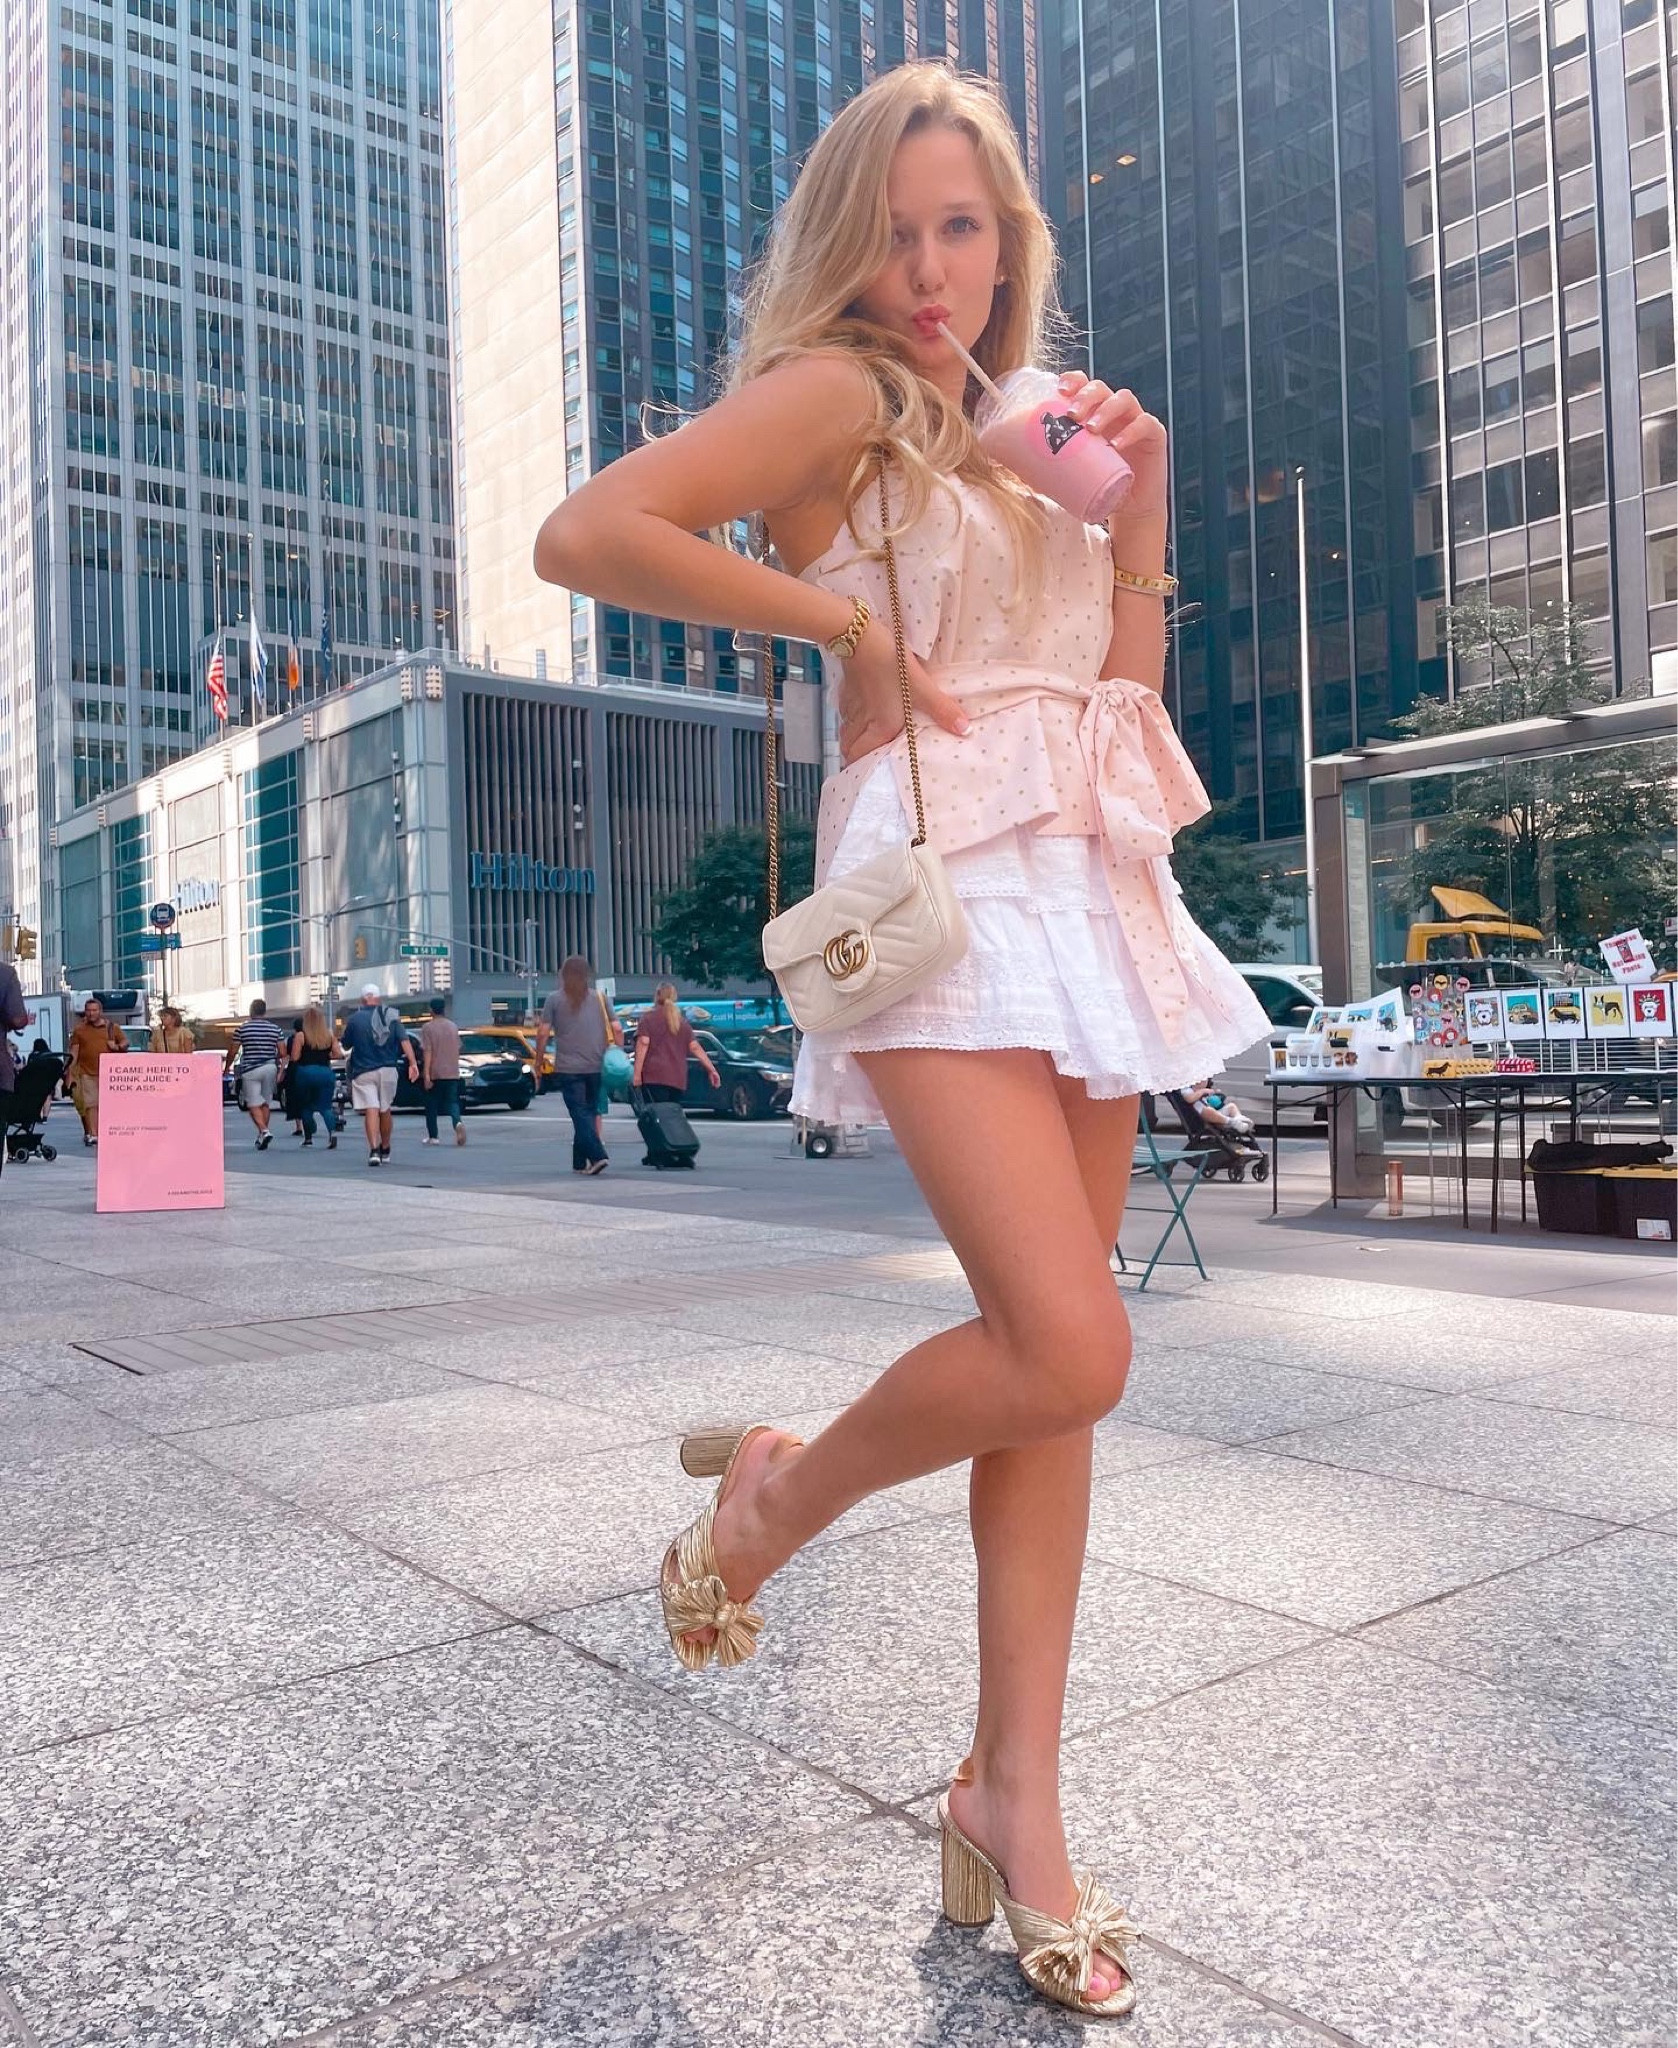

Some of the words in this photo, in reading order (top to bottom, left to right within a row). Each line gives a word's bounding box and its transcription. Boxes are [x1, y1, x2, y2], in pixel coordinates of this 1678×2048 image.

[470, 851, 596, 893] Hilton
[176, 877, 220, 915] Hilton
[109, 1066, 113, 1074] I
[115, 1066, 144, 1074] CAME
[147, 1066, 173, 1074] HERE
[176, 1066, 190, 1074] TO
[109, 1075, 140, 1083] DRINK
[143, 1075, 171, 1083] JUICE
